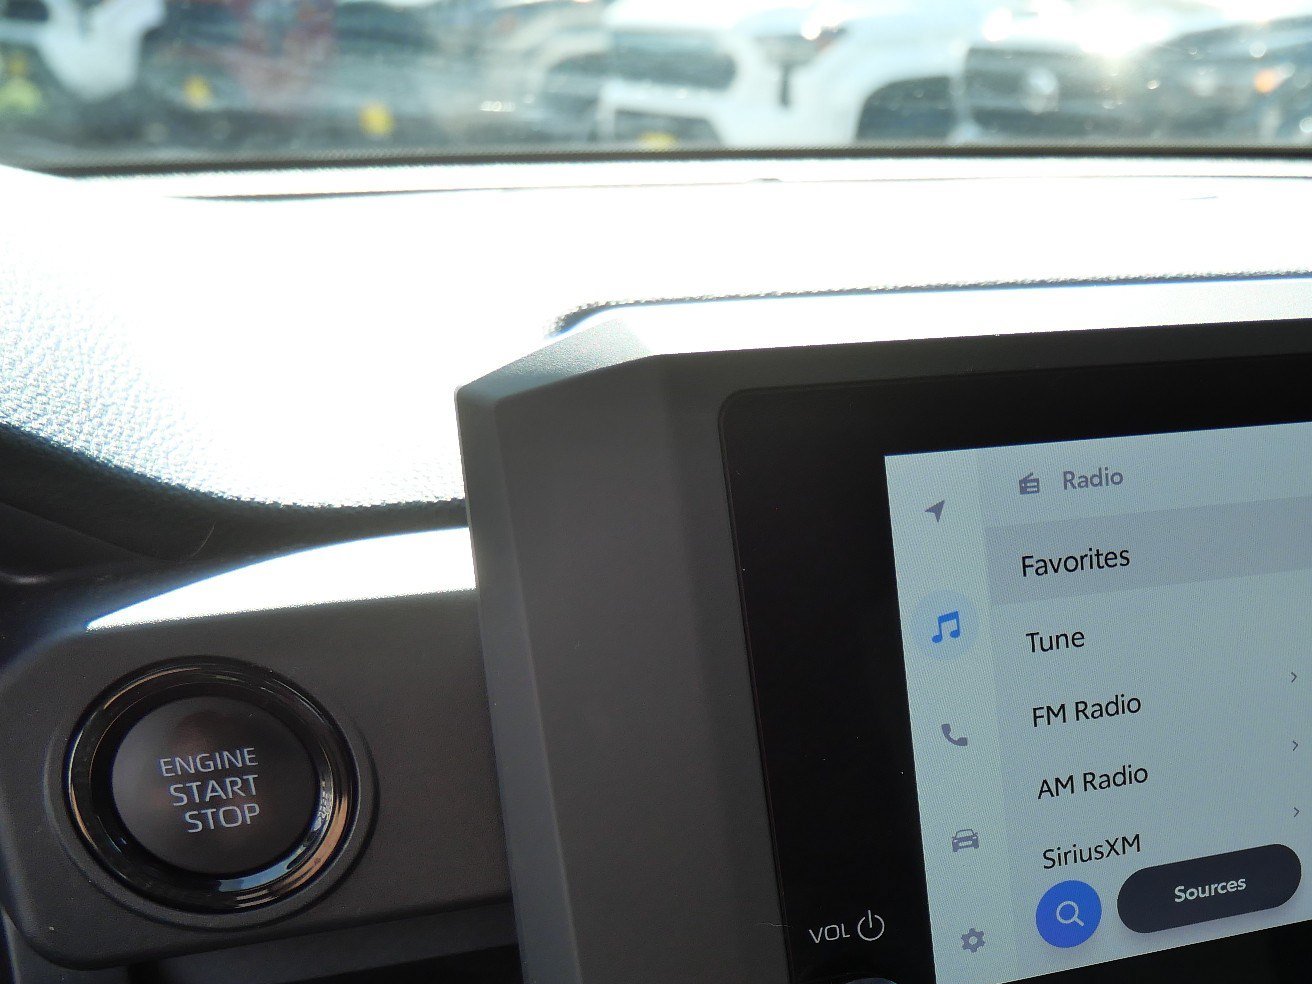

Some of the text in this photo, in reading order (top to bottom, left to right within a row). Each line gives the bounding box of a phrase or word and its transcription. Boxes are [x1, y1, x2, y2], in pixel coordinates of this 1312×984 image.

[1063, 467, 1124, 490] Radio
[1021, 547, 1130, 577] Favorites
[1026, 629, 1085, 652] Tune
[1032, 694, 1142, 727] FM Radio
[159, 747, 259, 777] ENGINE
[169, 774, 259, 806] START
[1037, 764, 1148, 799] AM Radio
[184, 803, 260, 833] STOP
[1043, 834, 1141, 869] SiriusXM
[1174, 877, 1246, 902] Sources
[809, 923, 850, 944] VOL
